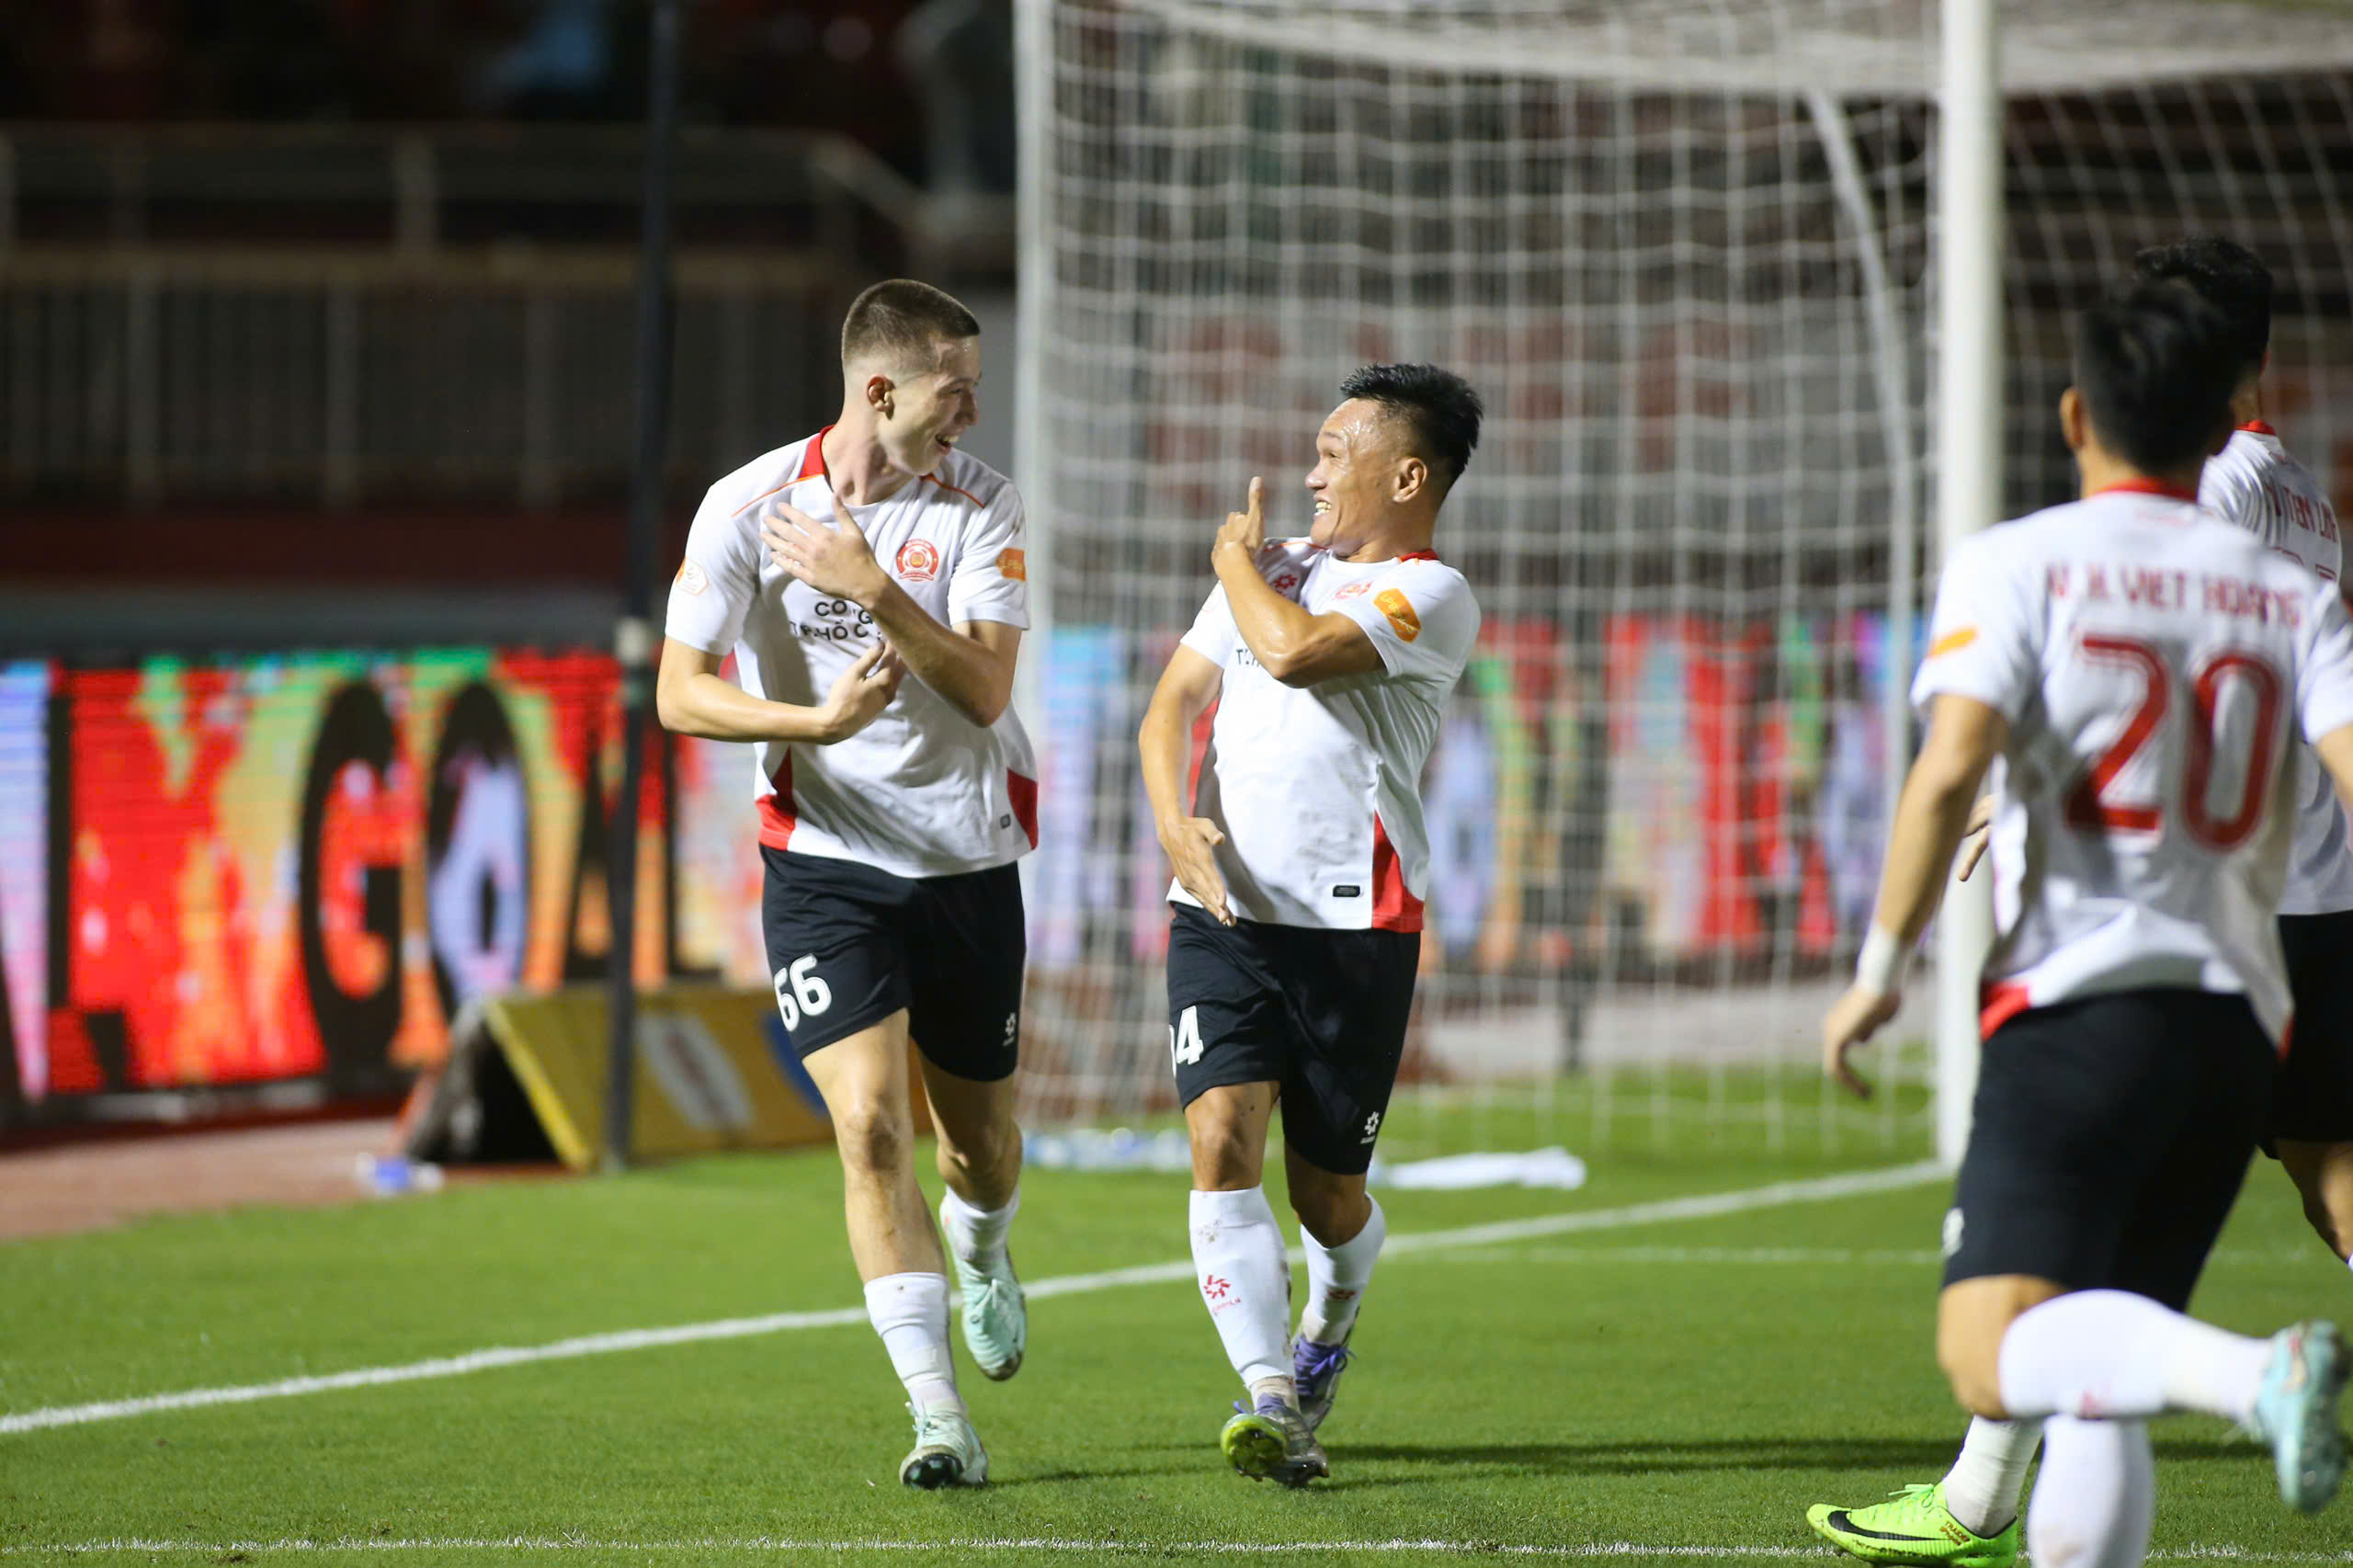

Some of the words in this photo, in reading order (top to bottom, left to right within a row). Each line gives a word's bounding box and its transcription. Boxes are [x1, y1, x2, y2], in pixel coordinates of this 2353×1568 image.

[2063, 634, 2279, 850] 20
[773, 952, 832, 1032] 66
[1169, 1005, 1204, 1078] 4
